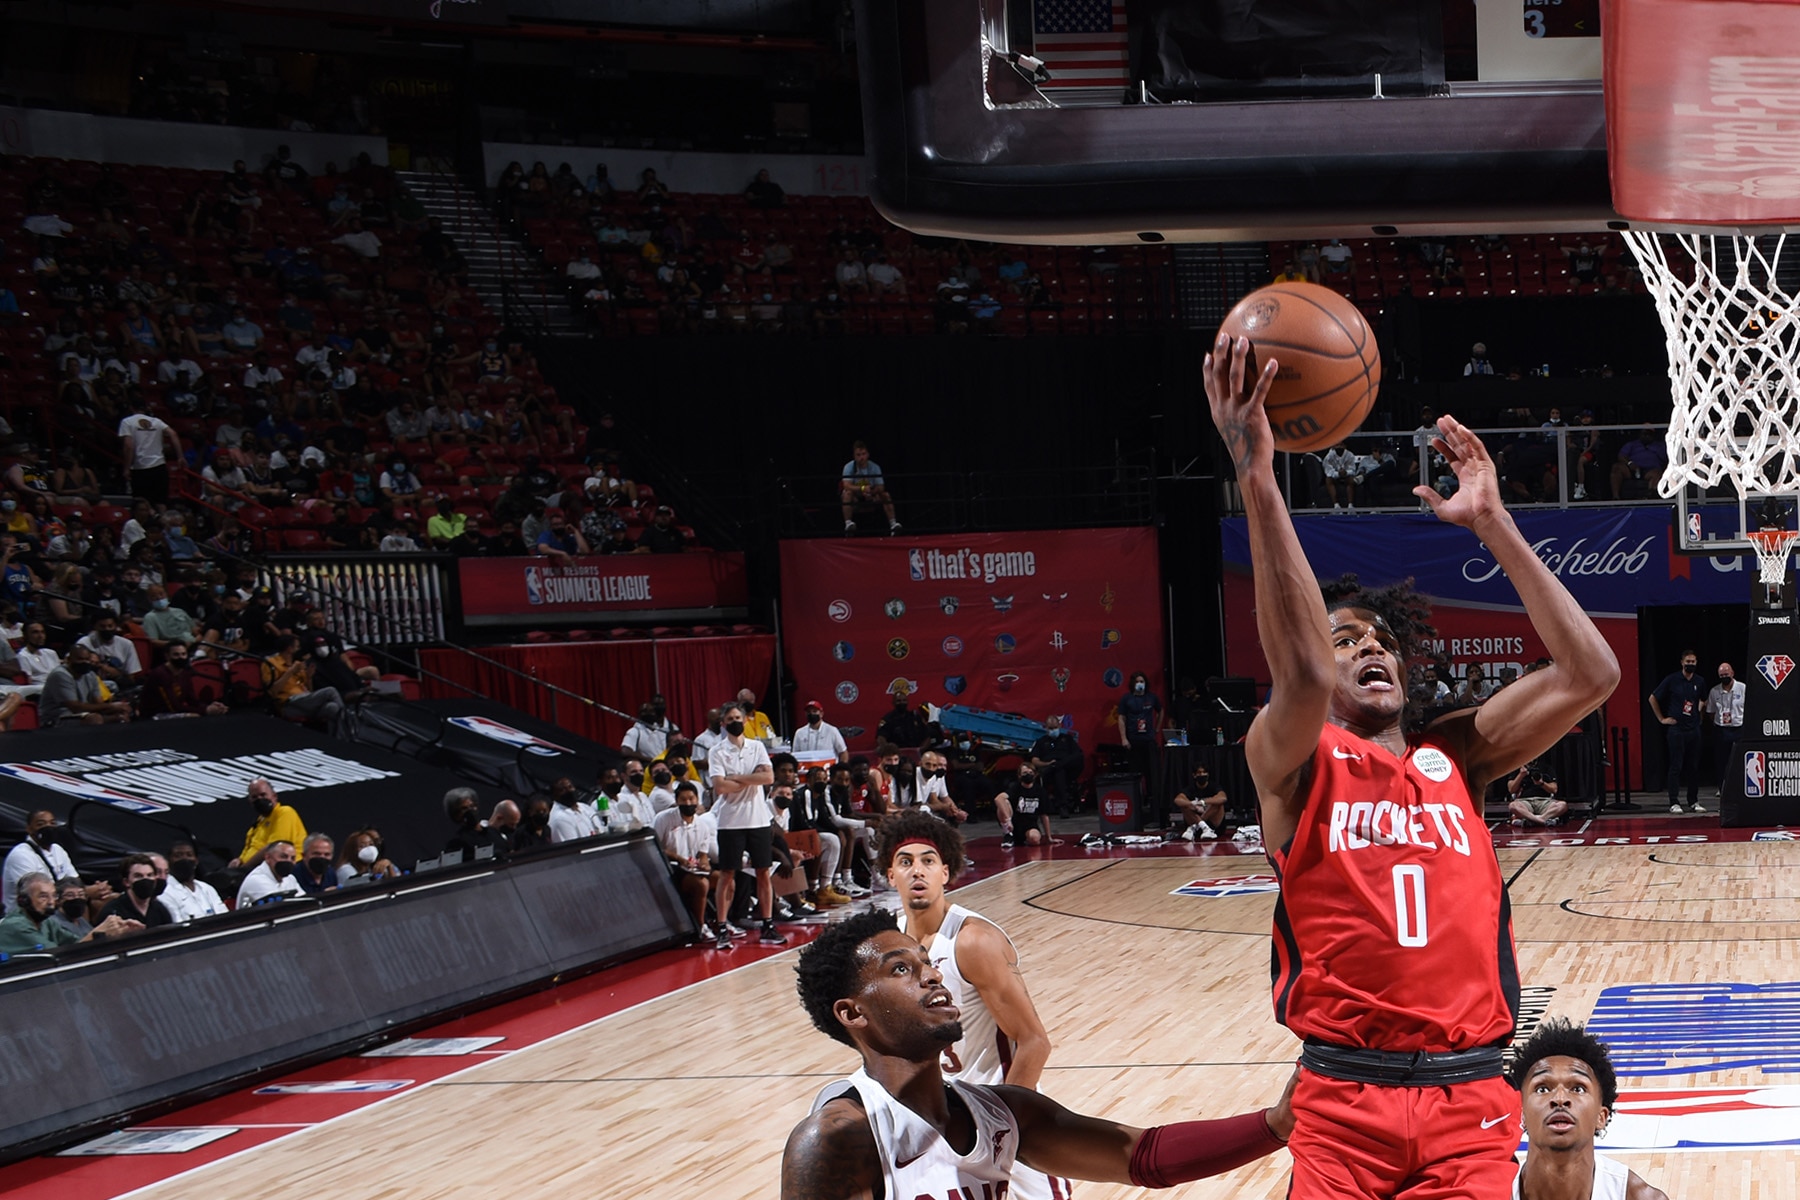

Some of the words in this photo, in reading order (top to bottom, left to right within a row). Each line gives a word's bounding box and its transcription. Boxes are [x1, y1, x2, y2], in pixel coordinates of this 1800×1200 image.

[983, 550, 1036, 584] game
[543, 576, 603, 604] SUMMER
[602, 574, 653, 602] LEAGUE
[1757, 616, 1791, 625] SPALDING
[1451, 636, 1524, 656] RESORTS
[1762, 719, 1791, 737] @NBA
[86, 747, 201, 771] RESORTS
[1416, 751, 1441, 762] credit
[1418, 758, 1447, 769] karma
[1767, 752, 1783, 760] MGM
[82, 758, 299, 808] SUMMER
[232, 748, 403, 790] LEAGUE
[1424, 766, 1448, 774] MONEY
[1328, 800, 1471, 857] ROCKETS
[1392, 864, 1428, 948] 0
